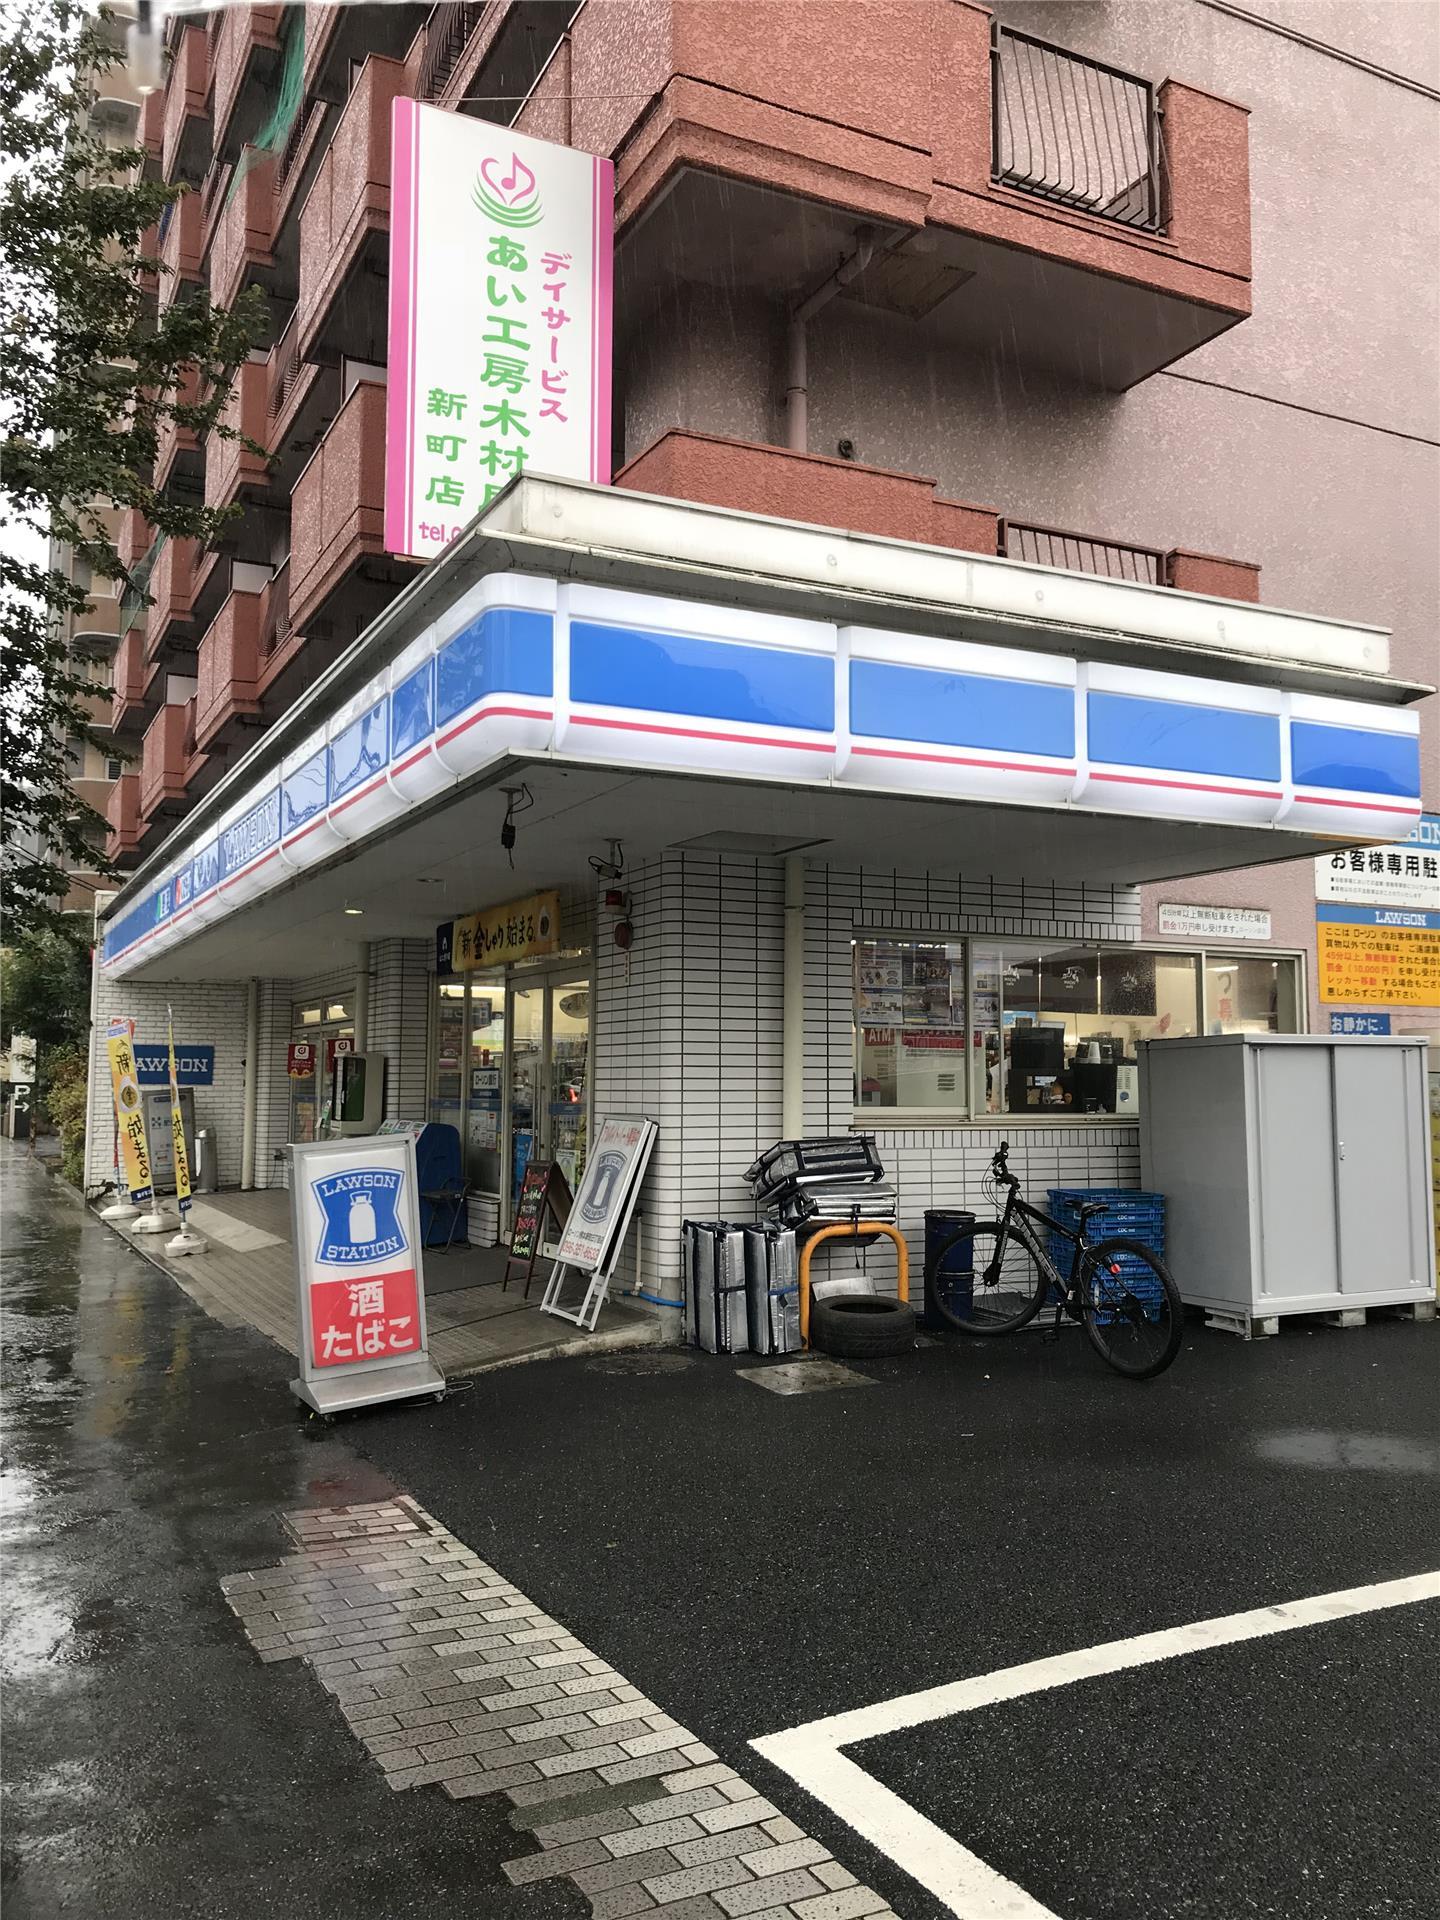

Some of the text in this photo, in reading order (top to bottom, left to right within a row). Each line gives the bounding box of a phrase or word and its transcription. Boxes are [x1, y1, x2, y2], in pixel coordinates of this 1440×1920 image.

[425, 388, 468, 507] 新町店
[1375, 911, 1427, 926] LAWSON
[321, 1174, 396, 1197] LAWSON
[326, 1236, 400, 1259] STATION
[349, 1280, 385, 1317] 酒
[321, 1315, 414, 1359] たばこ
